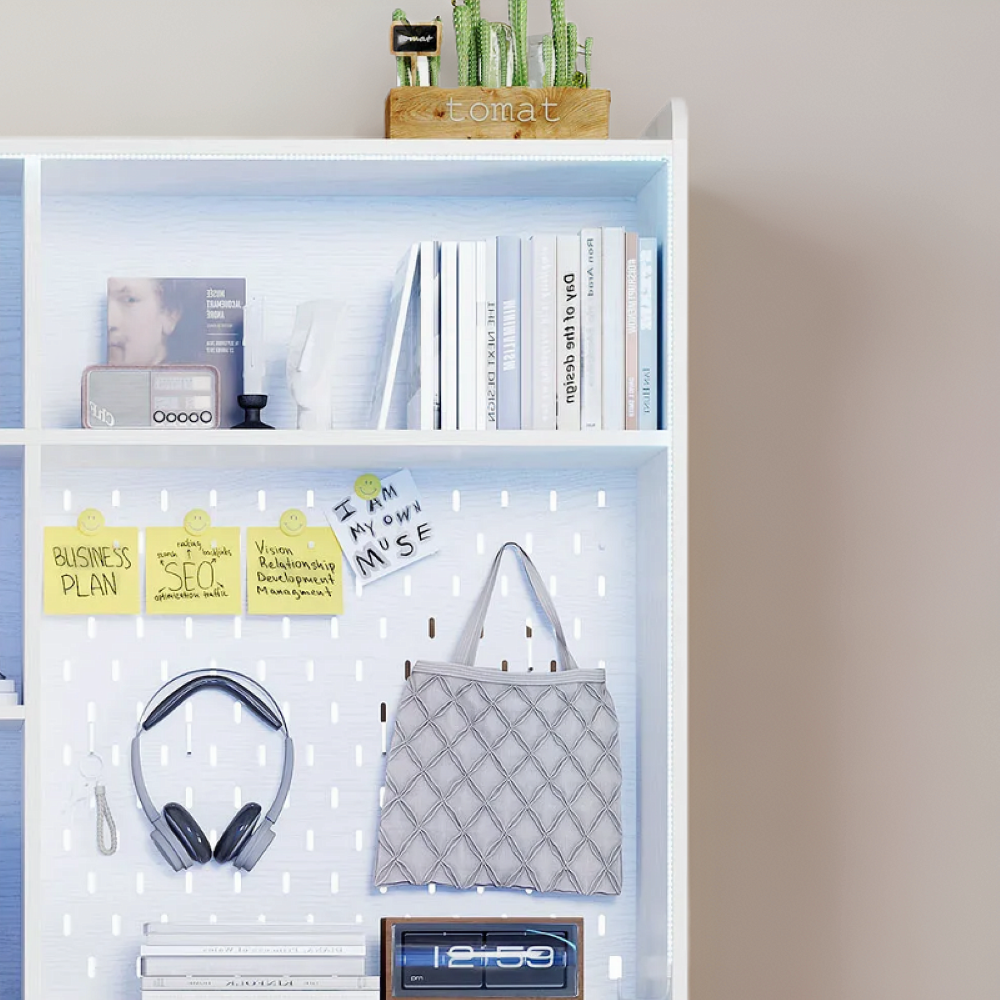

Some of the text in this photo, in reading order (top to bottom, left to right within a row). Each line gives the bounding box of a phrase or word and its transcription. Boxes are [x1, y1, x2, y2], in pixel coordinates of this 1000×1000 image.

[445, 96, 560, 122] tomat
[332, 484, 399, 522] I AM
[349, 500, 422, 541] MY OWN
[52, 546, 131, 570] BUSINESS
[255, 539, 294, 556] Vision
[355, 522, 432, 576] MUSE
[164, 561, 214, 591] SEO
[258, 556, 336, 575] Relationship
[60, 572, 117, 597] PLAN
[256, 572, 336, 586] Development
[256, 586, 333, 600] Managment
